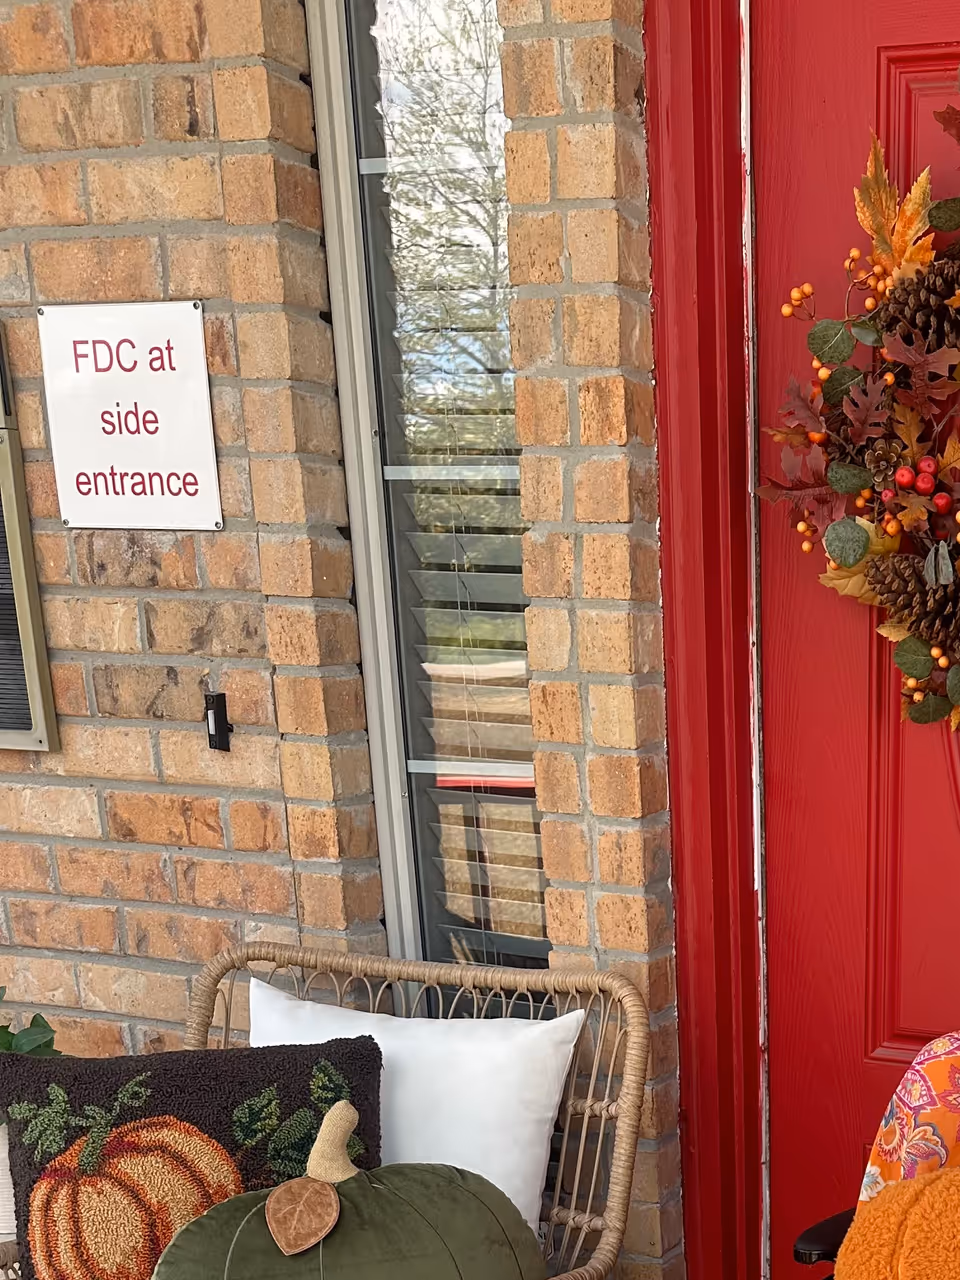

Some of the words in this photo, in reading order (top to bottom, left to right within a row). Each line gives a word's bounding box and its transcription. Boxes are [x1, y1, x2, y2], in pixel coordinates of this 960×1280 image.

[72, 338, 138, 373] FDC
[148, 338, 176, 372] at
[100, 402, 159, 435] side
[75, 465, 199, 497] entrance
